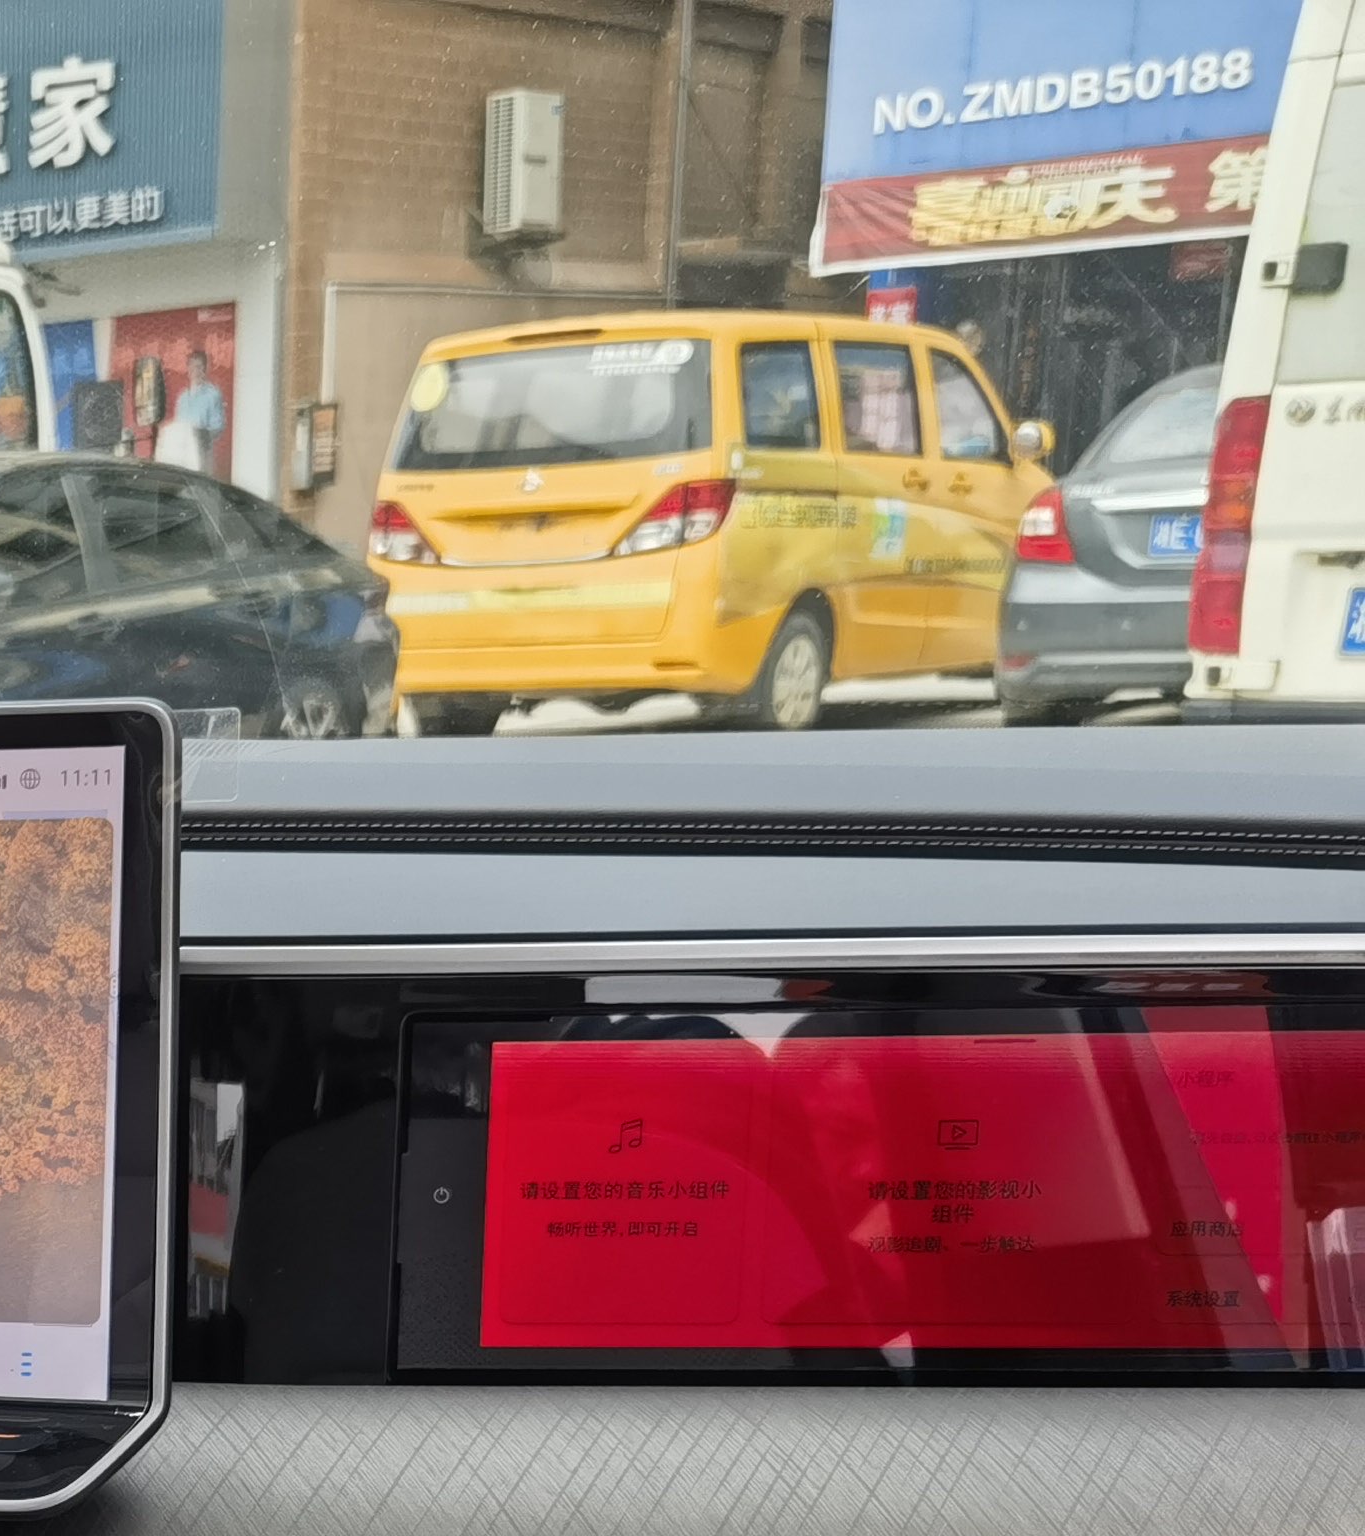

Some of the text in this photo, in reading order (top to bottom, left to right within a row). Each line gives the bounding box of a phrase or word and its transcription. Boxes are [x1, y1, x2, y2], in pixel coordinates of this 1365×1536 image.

[872, 47, 1253, 135] NO.ZMDB50188
[60, 769, 112, 787] 11:11
[520, 1181, 731, 1201] 请设置您的音乐小组件
[867, 1180, 1042, 1200] 请设置您的影视小
[931, 1204, 975, 1224] 组件
[1170, 1220, 1244, 1237] 应用商店
[1165, 1290, 1241, 1308] 系统设置
